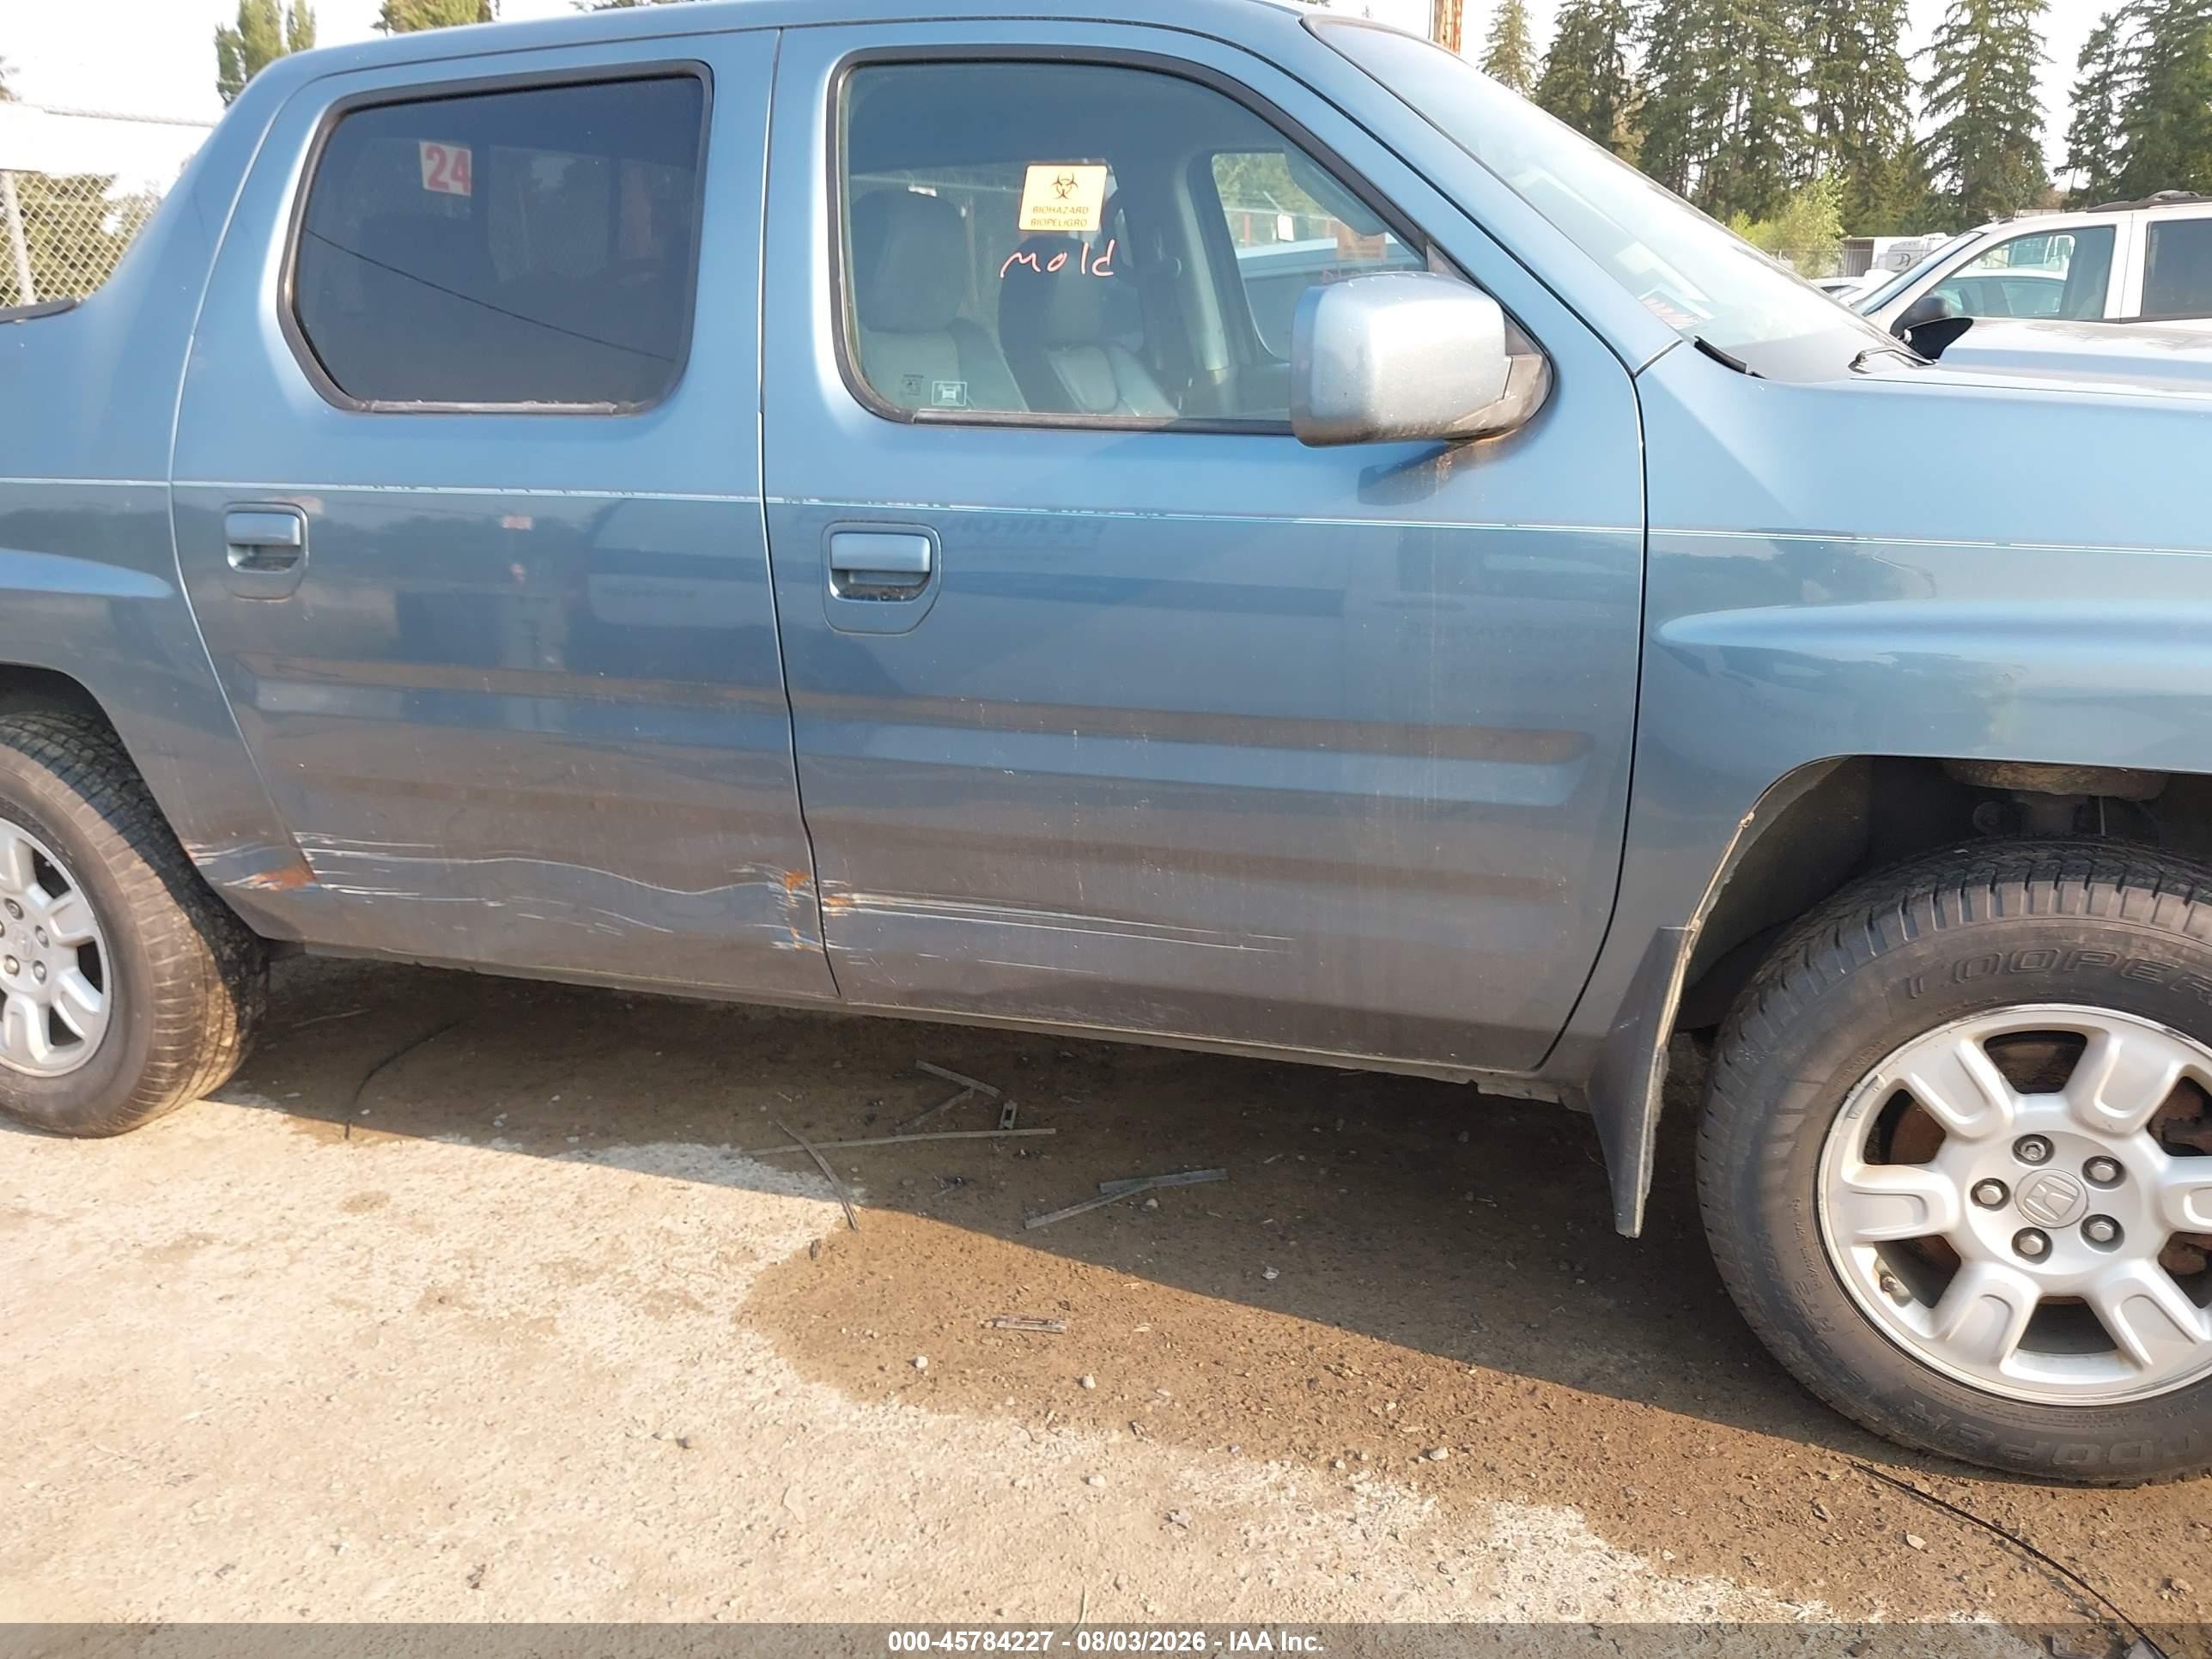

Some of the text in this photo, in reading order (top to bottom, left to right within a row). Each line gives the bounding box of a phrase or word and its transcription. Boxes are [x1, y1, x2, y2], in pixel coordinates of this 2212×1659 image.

[425, 144, 471, 194] 24
[1032, 205, 1090, 215] BIOHAZARD
[1030, 218, 1088, 228] BIOPELIGRO
